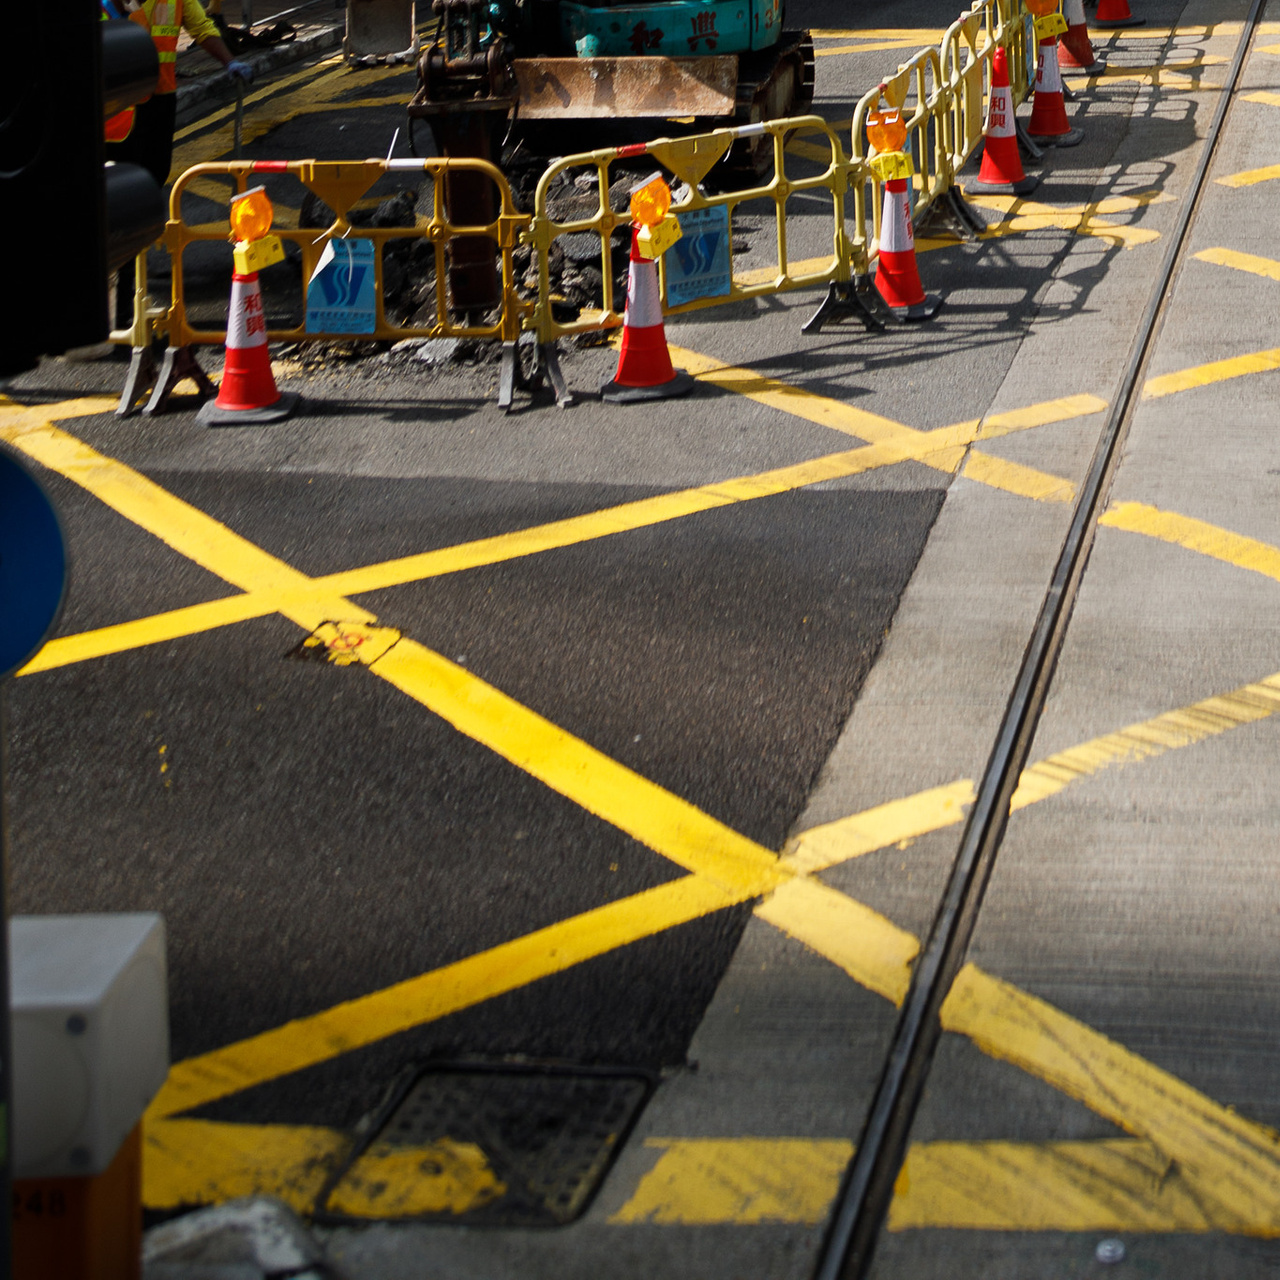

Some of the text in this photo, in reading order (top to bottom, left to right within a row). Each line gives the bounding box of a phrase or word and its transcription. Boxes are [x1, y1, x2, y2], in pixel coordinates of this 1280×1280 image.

[629, 10, 719, 55] 和興
[990, 96, 1006, 130] 和興
[243, 292, 266, 337] 和興
